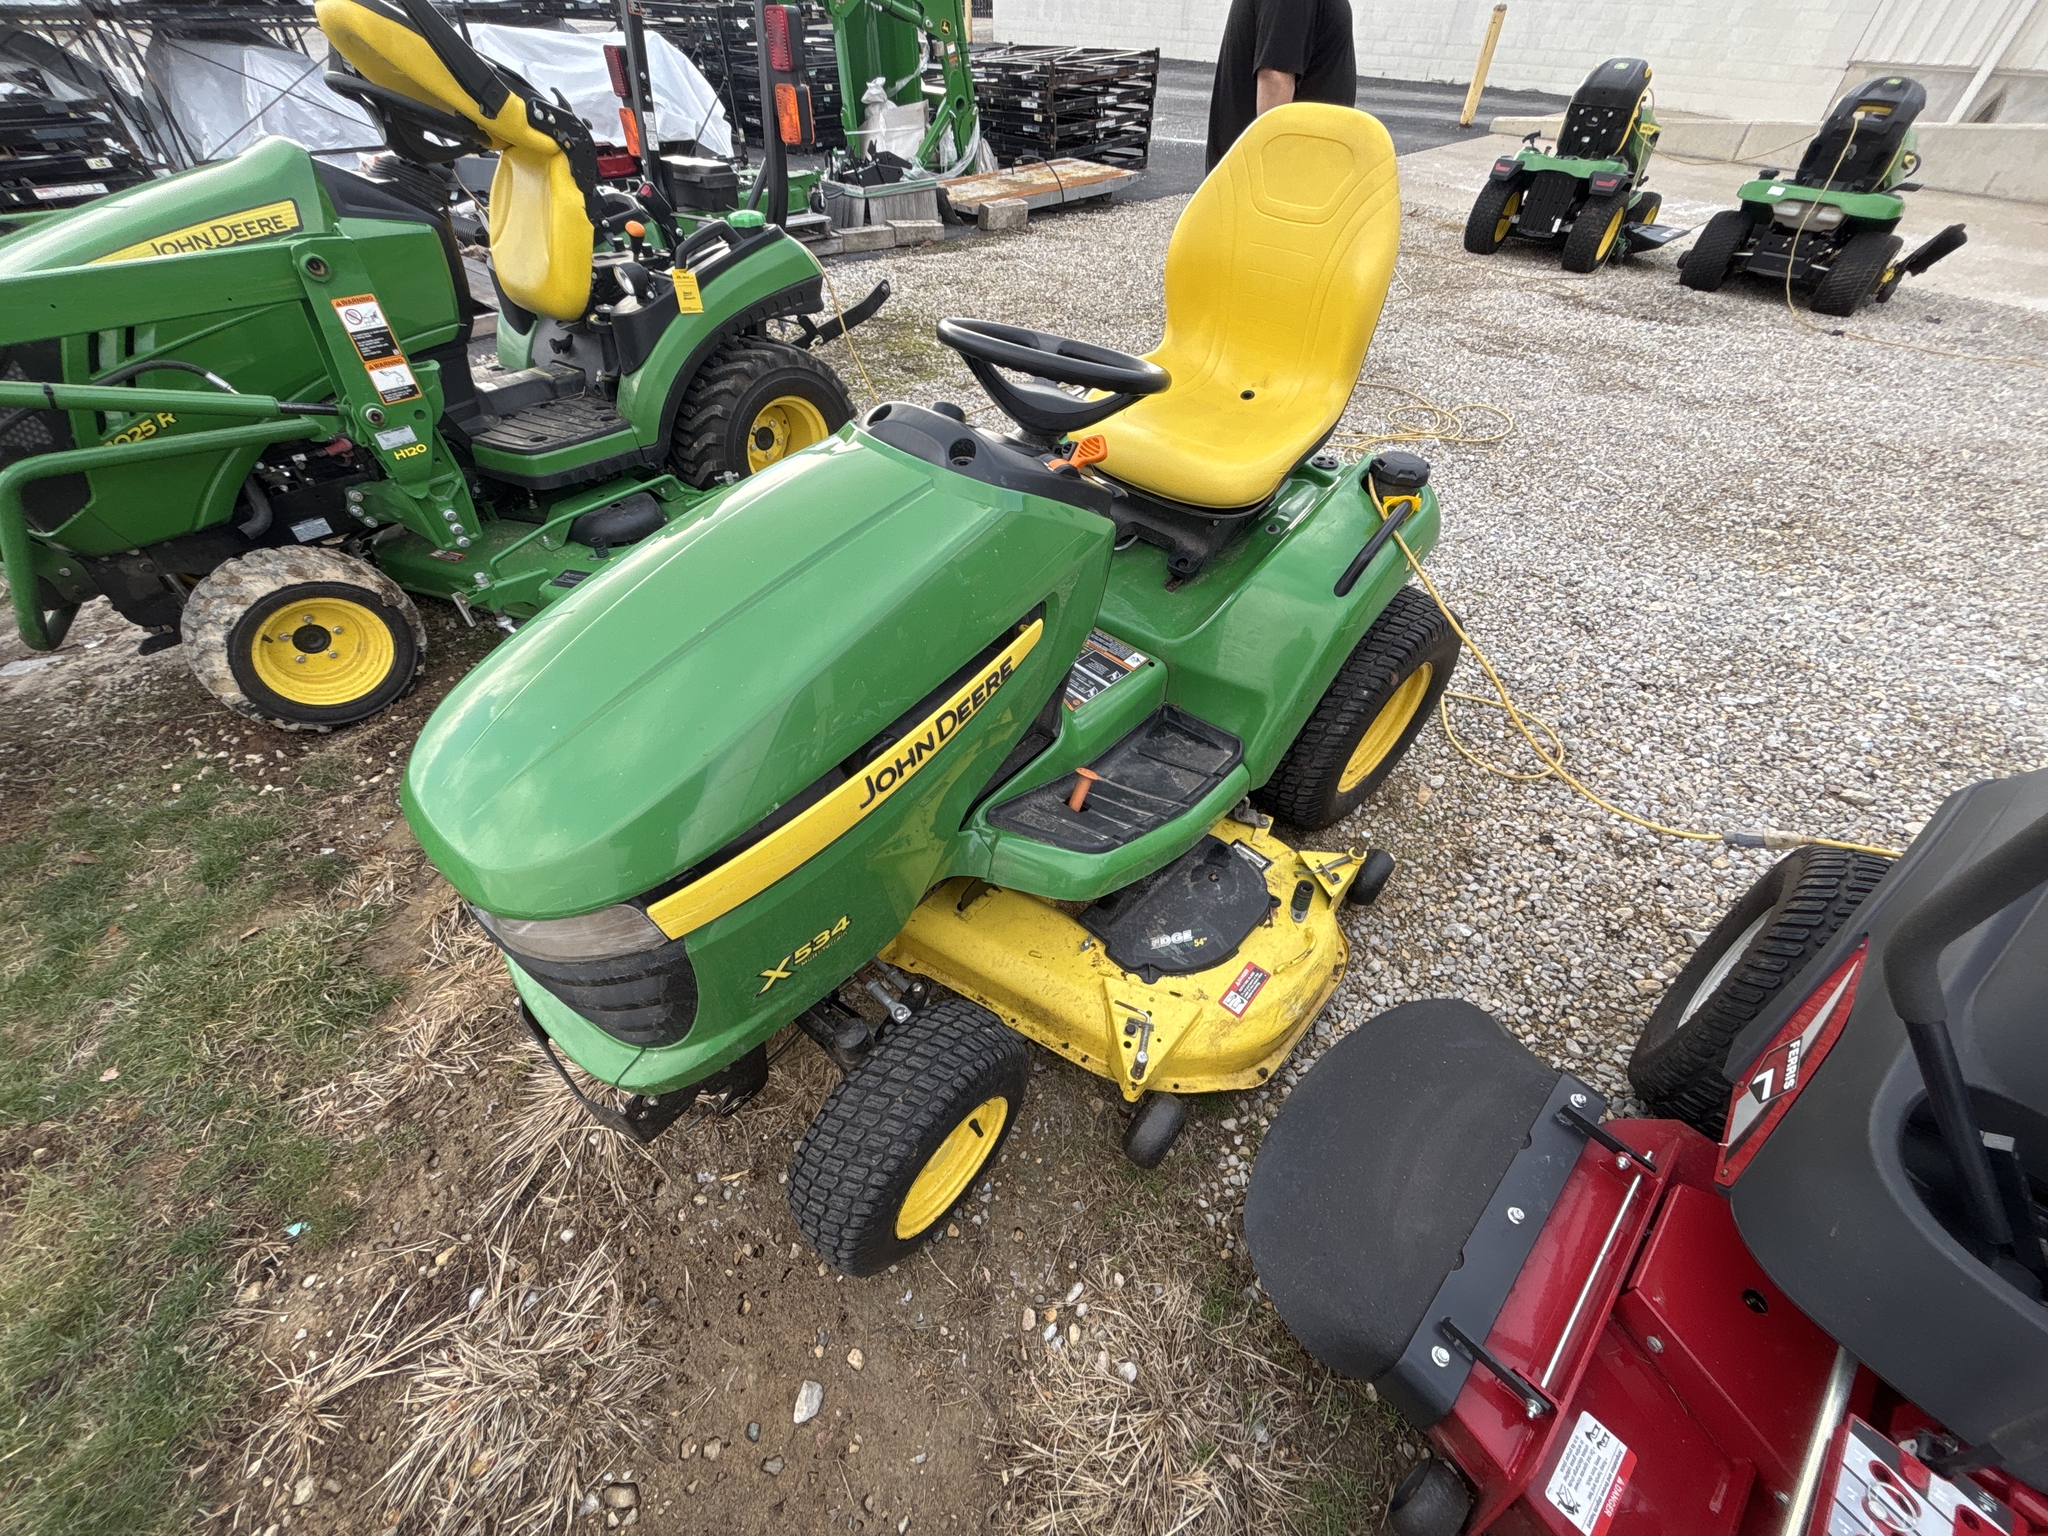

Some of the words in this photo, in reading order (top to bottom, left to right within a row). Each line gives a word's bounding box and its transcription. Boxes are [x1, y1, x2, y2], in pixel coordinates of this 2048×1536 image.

[151, 232, 214, 256] JOHN
[210, 215, 288, 244] DEERE
[340, 295, 374, 306] WARNING
[373, 358, 404, 369] WARNING
[393, 443, 427, 461] H120
[860, 731, 935, 810] JOHN
[935, 656, 1014, 743] DEERE
[758, 914, 851, 995] X534
[1783, 1039, 1801, 1090] FERRIS
[1604, 1484, 1623, 1517] DANGER
